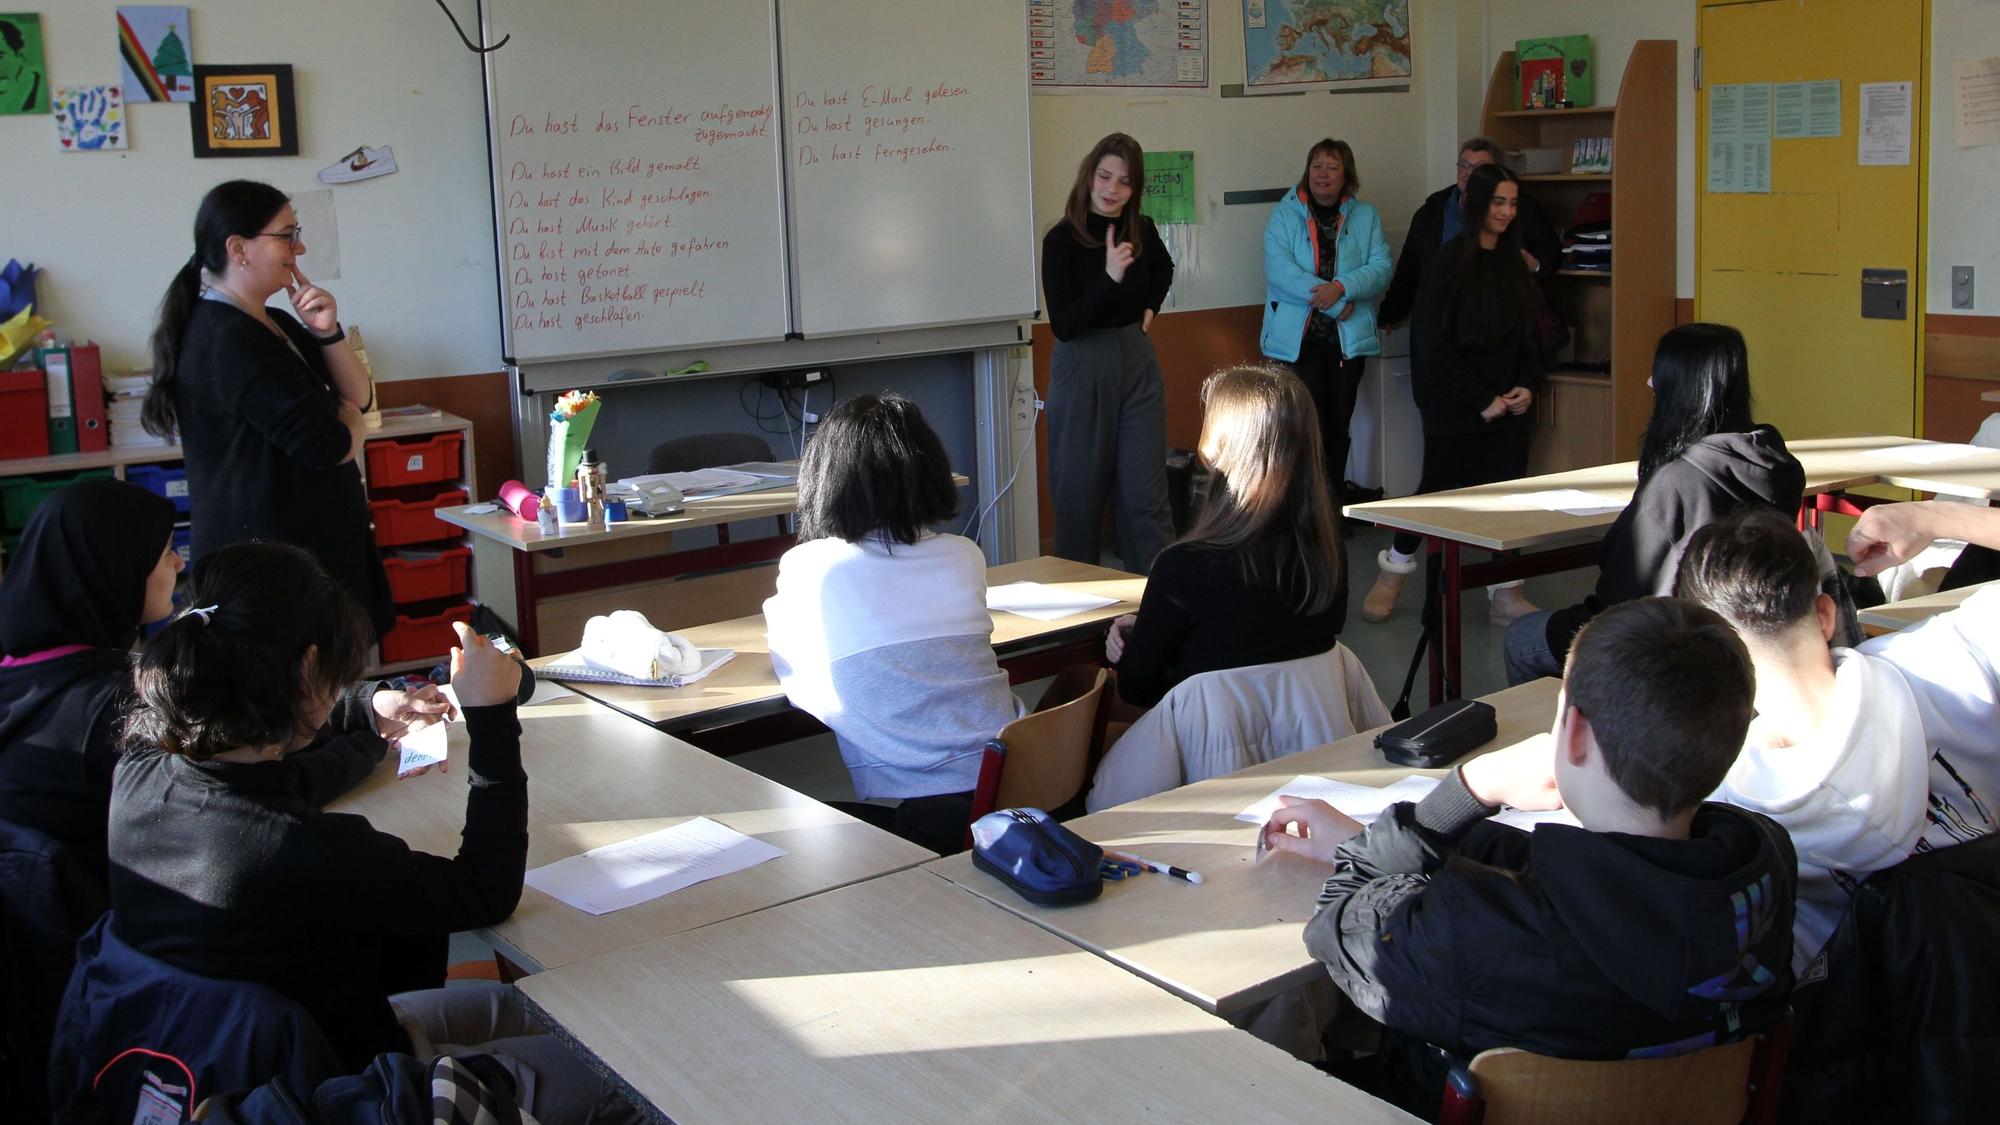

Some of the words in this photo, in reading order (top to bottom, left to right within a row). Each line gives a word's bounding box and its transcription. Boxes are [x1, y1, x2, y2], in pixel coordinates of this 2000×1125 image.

[796, 90, 815, 108] Du
[823, 89, 849, 105] hast
[861, 84, 913, 108] E-Mail
[510, 114, 533, 138] Du
[544, 111, 579, 135] hast
[595, 110, 619, 133] das
[627, 104, 692, 129] Fenster
[797, 115, 818, 135] Du
[825, 113, 852, 132] hast
[799, 144, 819, 167] Du
[831, 143, 862, 161] hast
[510, 160, 533, 182] Du
[542, 161, 570, 179] hast
[577, 165, 601, 178] ein
[610, 156, 641, 176] Bild
[509, 189, 530, 209] Du
[537, 190, 561, 209] hast
[568, 189, 591, 207] das
[601, 186, 633, 209] Kind
[510, 216, 530, 236] Du
[537, 216, 563, 235] hast
[575, 215, 618, 235] Musik
[513, 242, 530, 261] Du
[539, 239, 565, 260] bist
[573, 239, 599, 260] mit
[604, 239, 630, 257] dem
[636, 238, 662, 257] Auto
[514, 266, 533, 285] Du
[541, 264, 567, 282] hast
[516, 290, 535, 309] Du
[542, 288, 567, 306] hast
[513, 312, 534, 331] Du
[538, 310, 562, 329] hast
